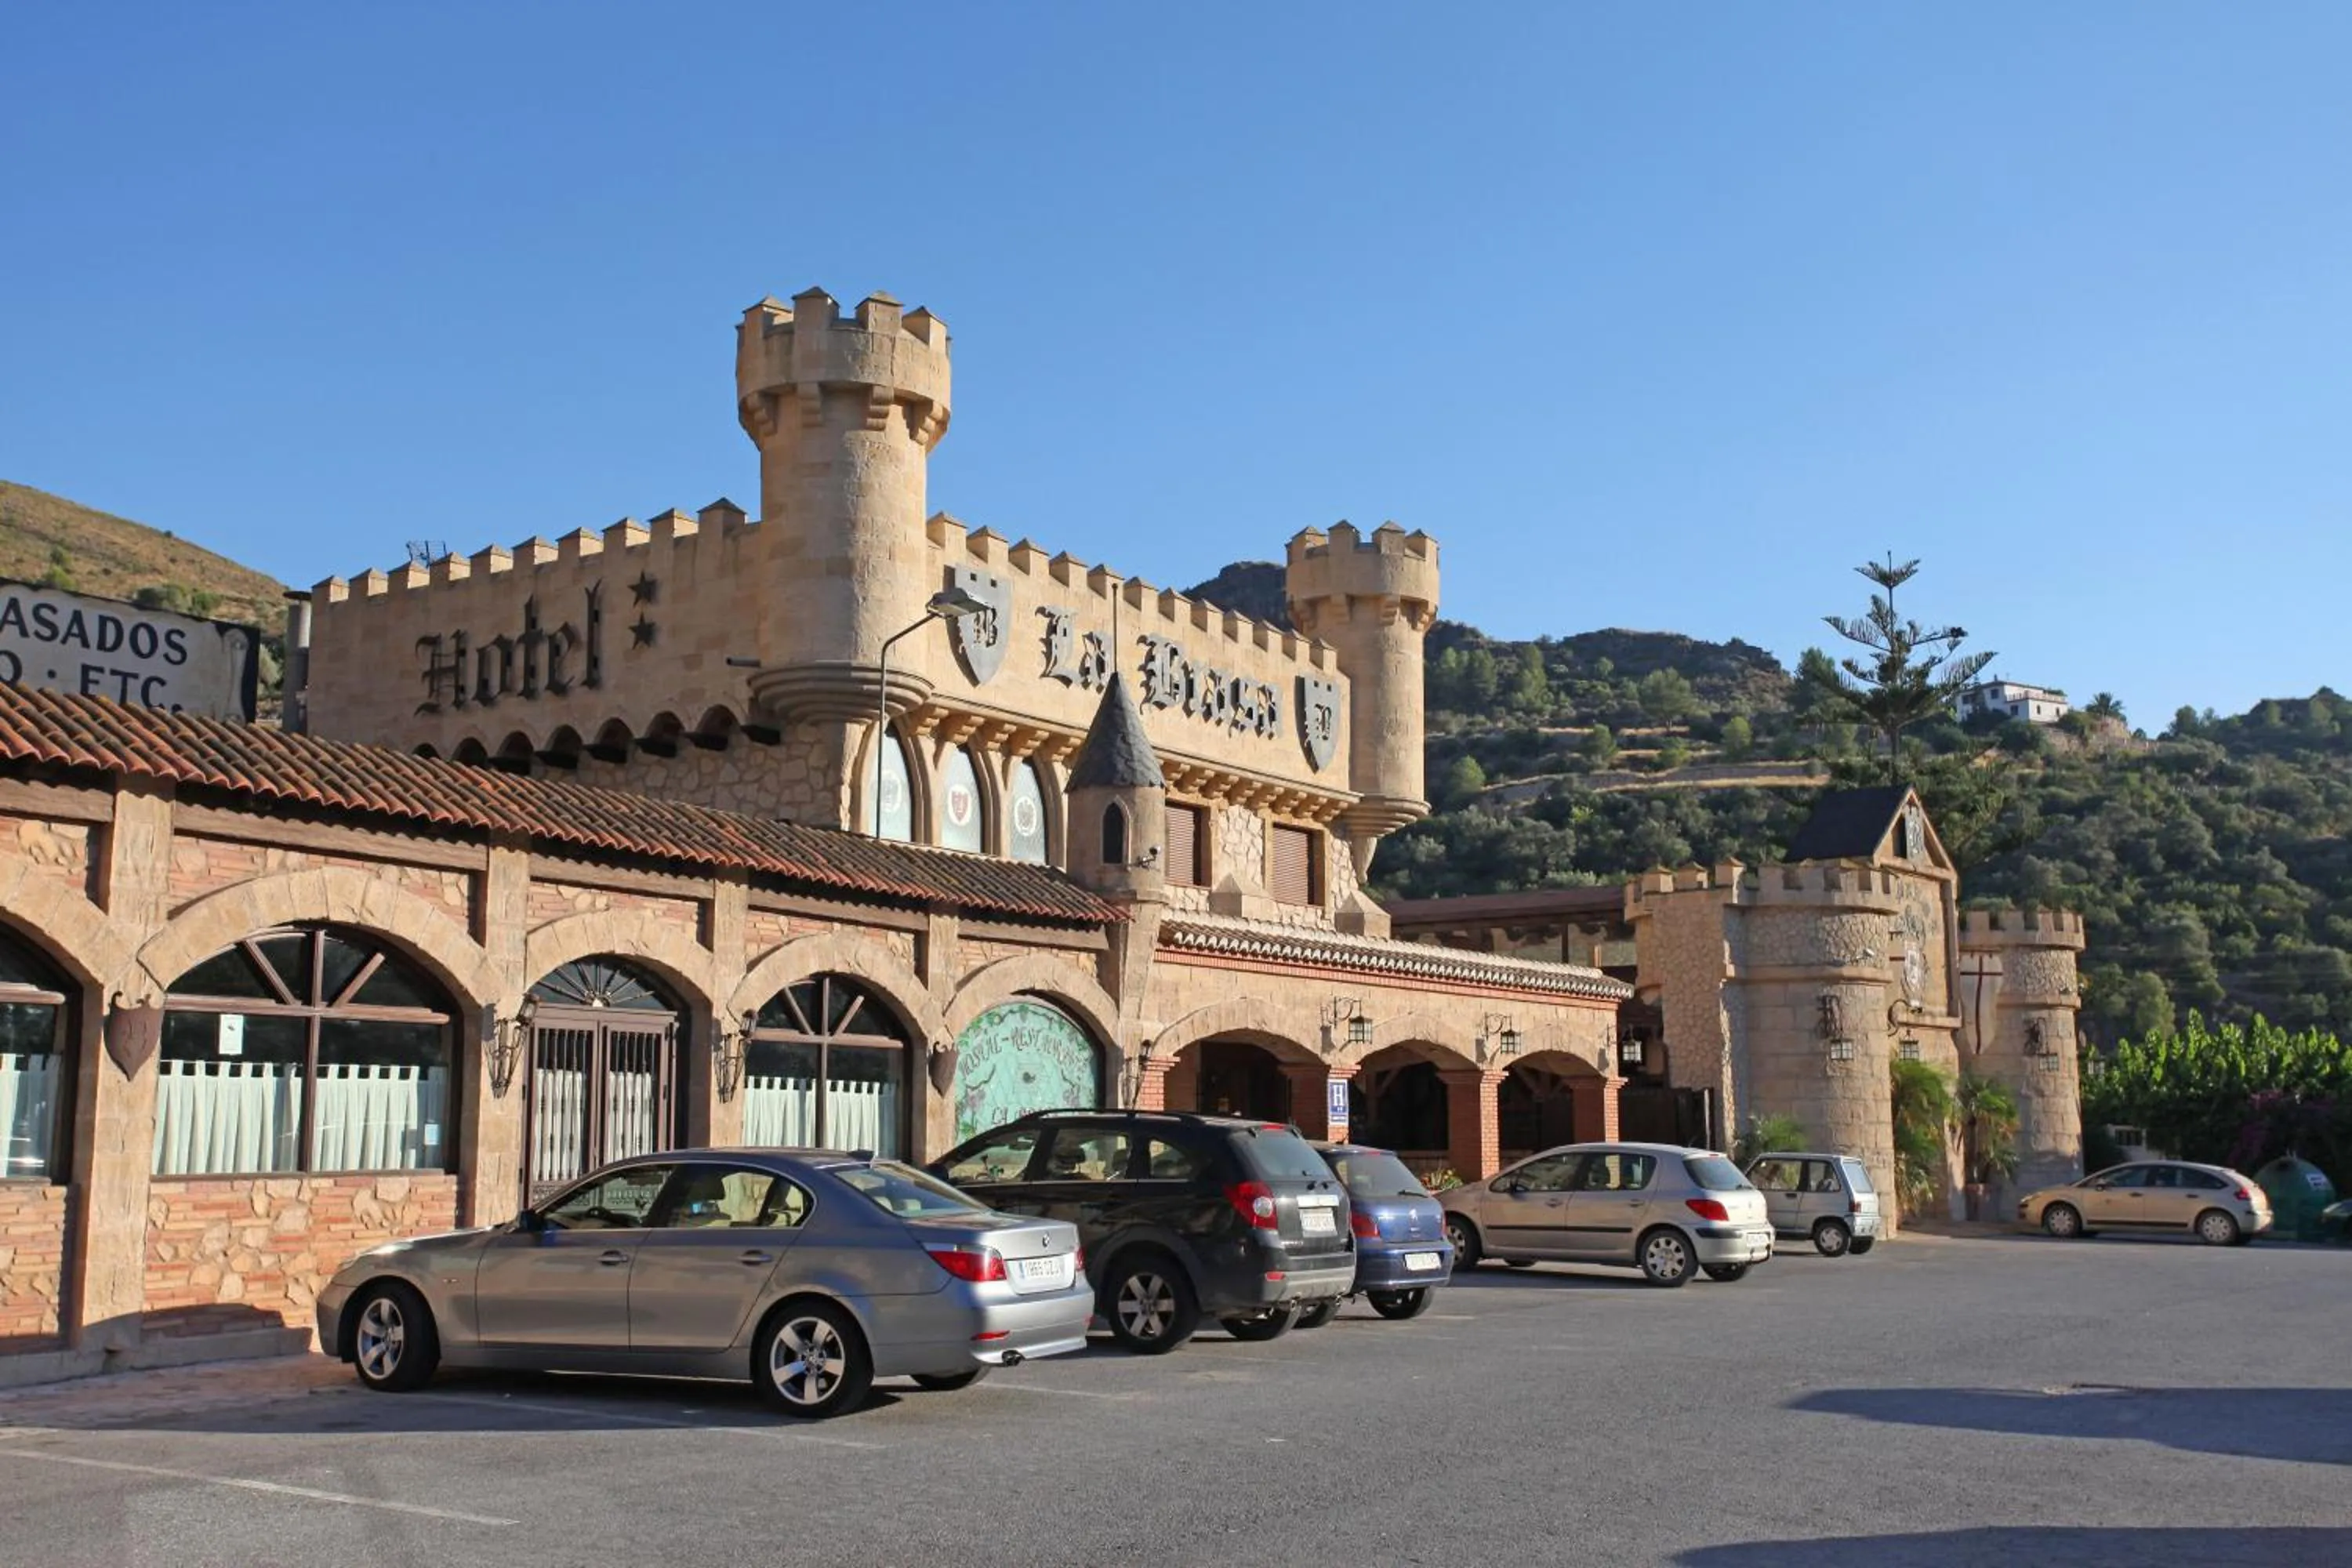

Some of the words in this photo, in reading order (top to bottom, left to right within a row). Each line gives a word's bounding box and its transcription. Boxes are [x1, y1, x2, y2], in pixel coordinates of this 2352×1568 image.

[0, 597, 187, 665] ASADOS
[414, 577, 601, 717] Hotel
[1035, 605, 1113, 694] La
[1136, 633, 1284, 740] Brasa
[1334, 1084, 1344, 1107] H
